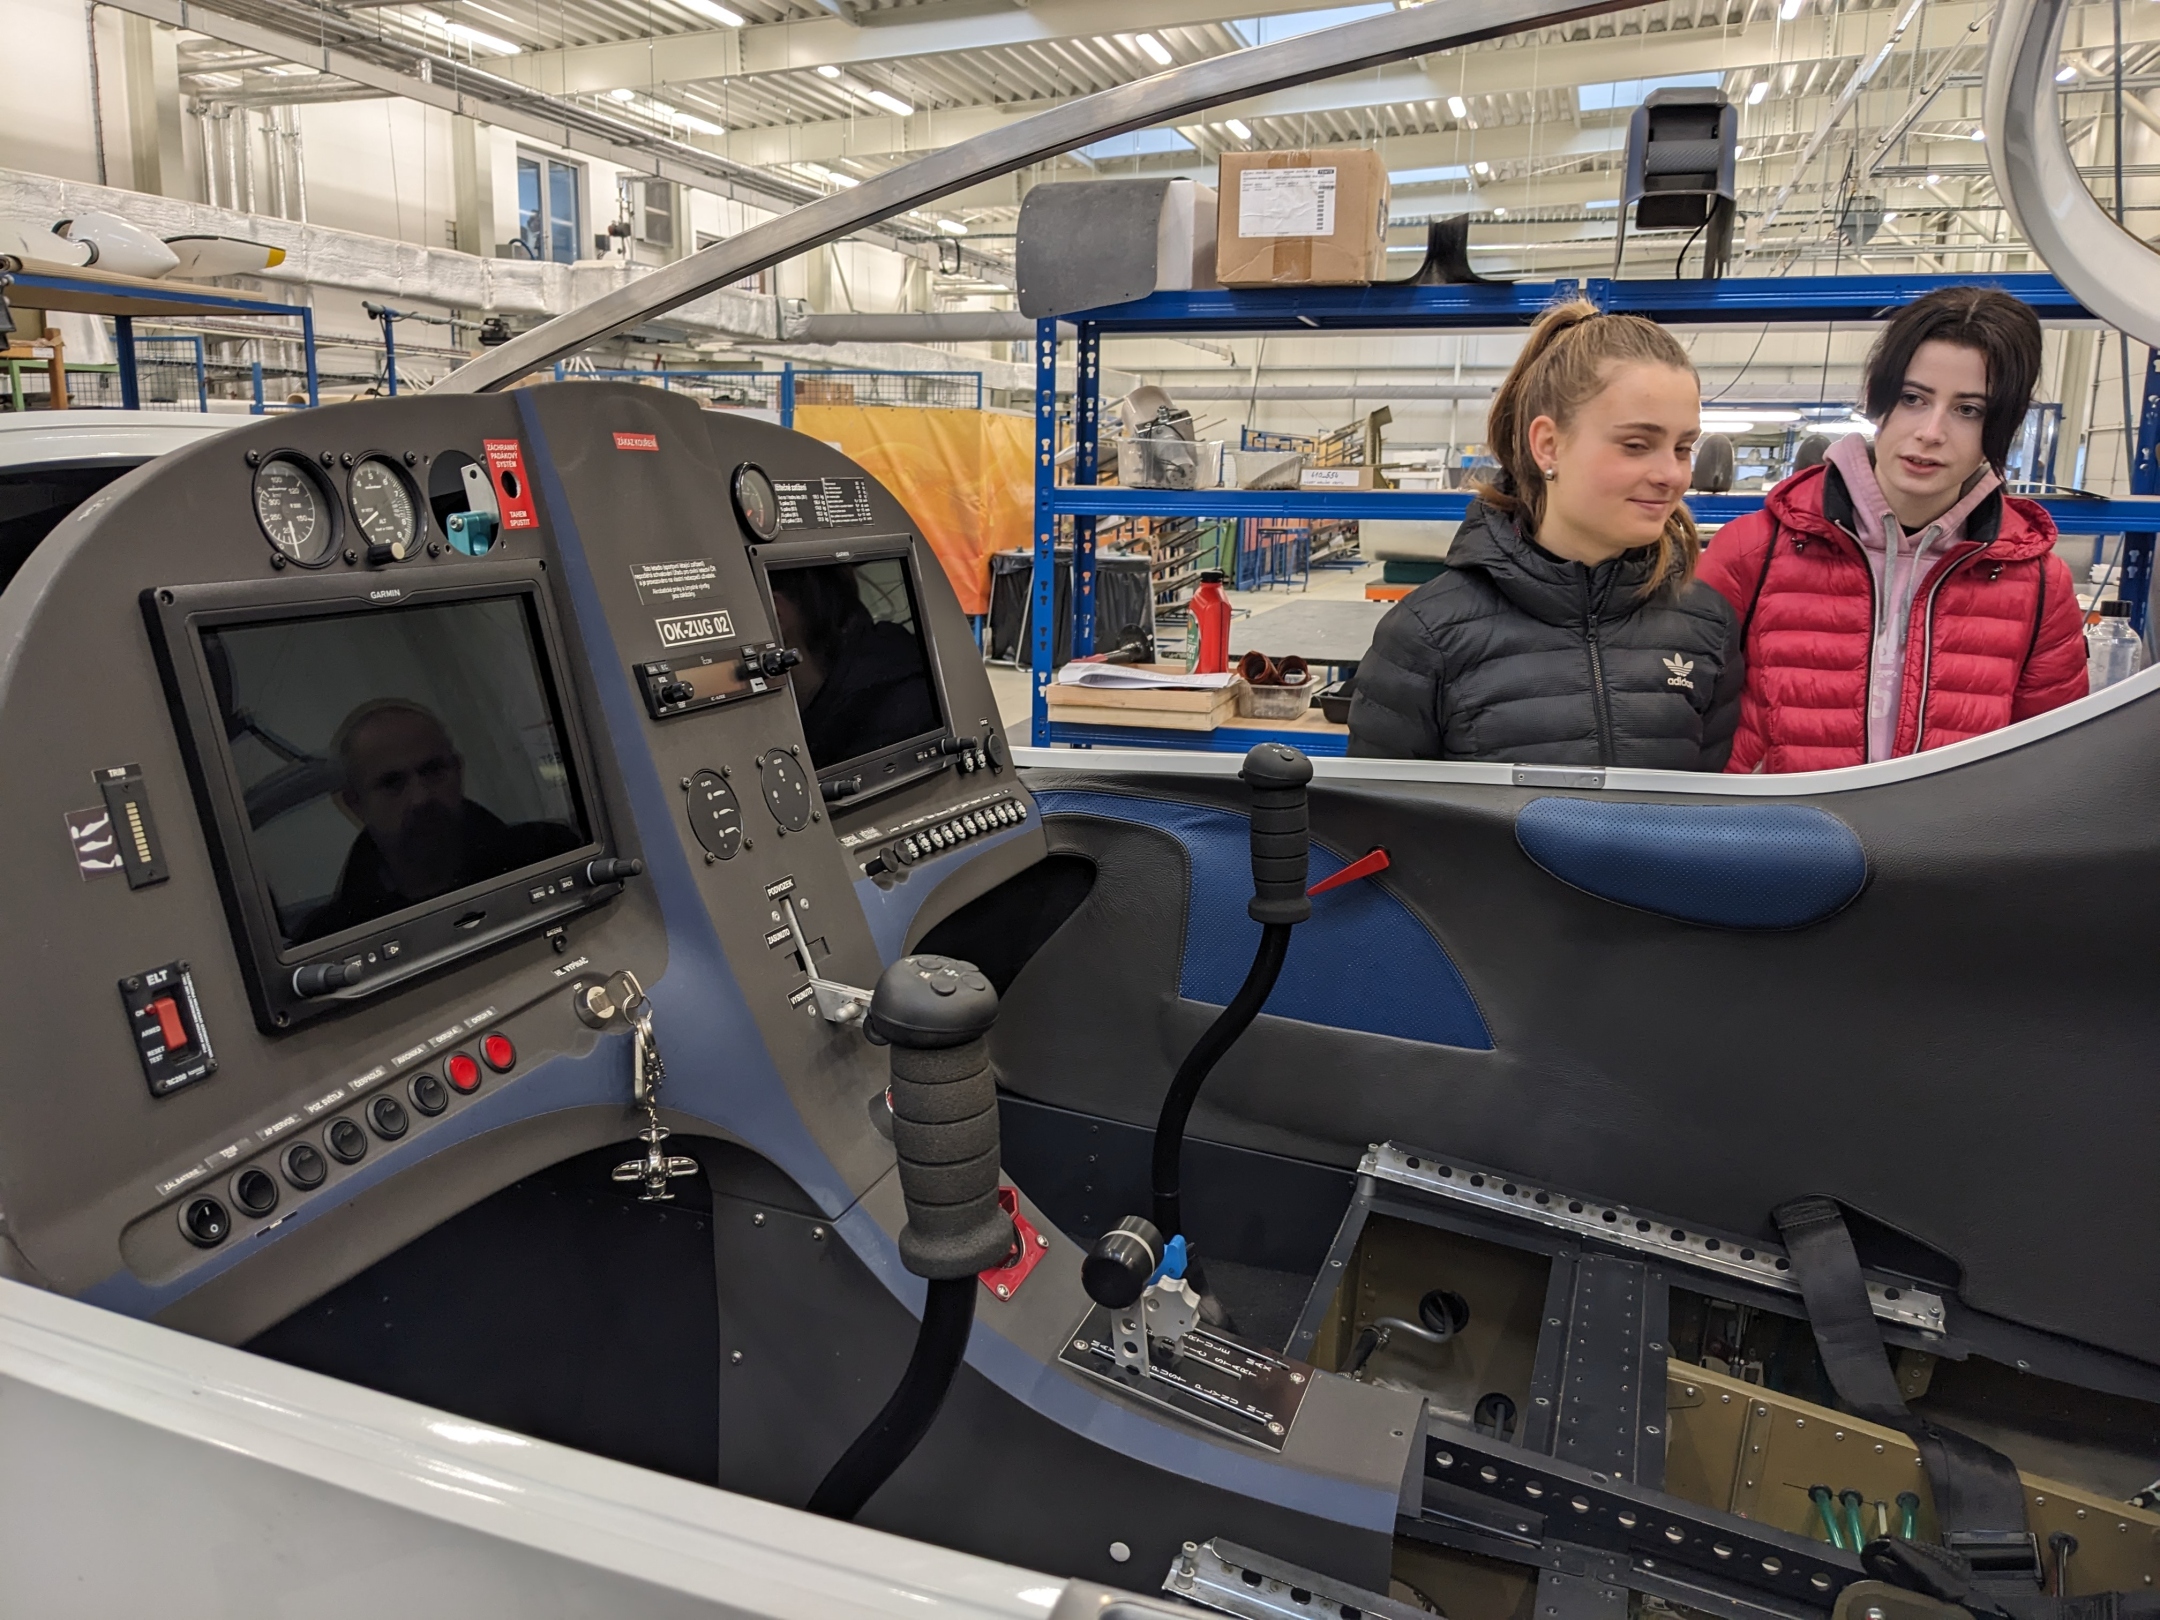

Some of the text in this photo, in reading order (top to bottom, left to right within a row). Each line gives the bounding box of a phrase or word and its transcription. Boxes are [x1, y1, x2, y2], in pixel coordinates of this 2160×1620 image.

[486, 443, 518, 451] ZÁCHRANNÝ
[490, 452, 518, 460] PADÁKOVÝ
[496, 460, 517, 468] SYSTÉM
[509, 510, 527, 518] TAHEM
[510, 518, 530, 526] SPUSTIT
[370, 589, 401, 599] GARMIN
[663, 616, 730, 641] OK-ZUG 02
[108, 767, 126, 778] TRIM
[767, 879, 794, 896] PODVOZEK
[767, 928, 791, 945] ZASUNUTO
[146, 970, 168, 986] ELT
[790, 987, 814, 1005] VYSUNUTO
[135, 1009, 145, 1017] ON
[141, 1025, 161, 1038] ARMED
[147, 1046, 165, 1058] RESET
[397, 1047, 424, 1065] AVIONIKA
[149, 1054, 163, 1065] TEST
[353, 1069, 383, 1088] ČERPADLO
[308, 1088, 345, 1114] POZ. SVĚTLA
[263, 1116, 295, 1137] AP SERVOS
[219, 1145, 239, 1158] TRIM
[1214, 1357, 1257, 1377] START
[1245, 1357, 1272, 1372] MAX
[1194, 1383, 1239, 1405] PLYNU
[1246, 1404, 1274, 1419] MIN
